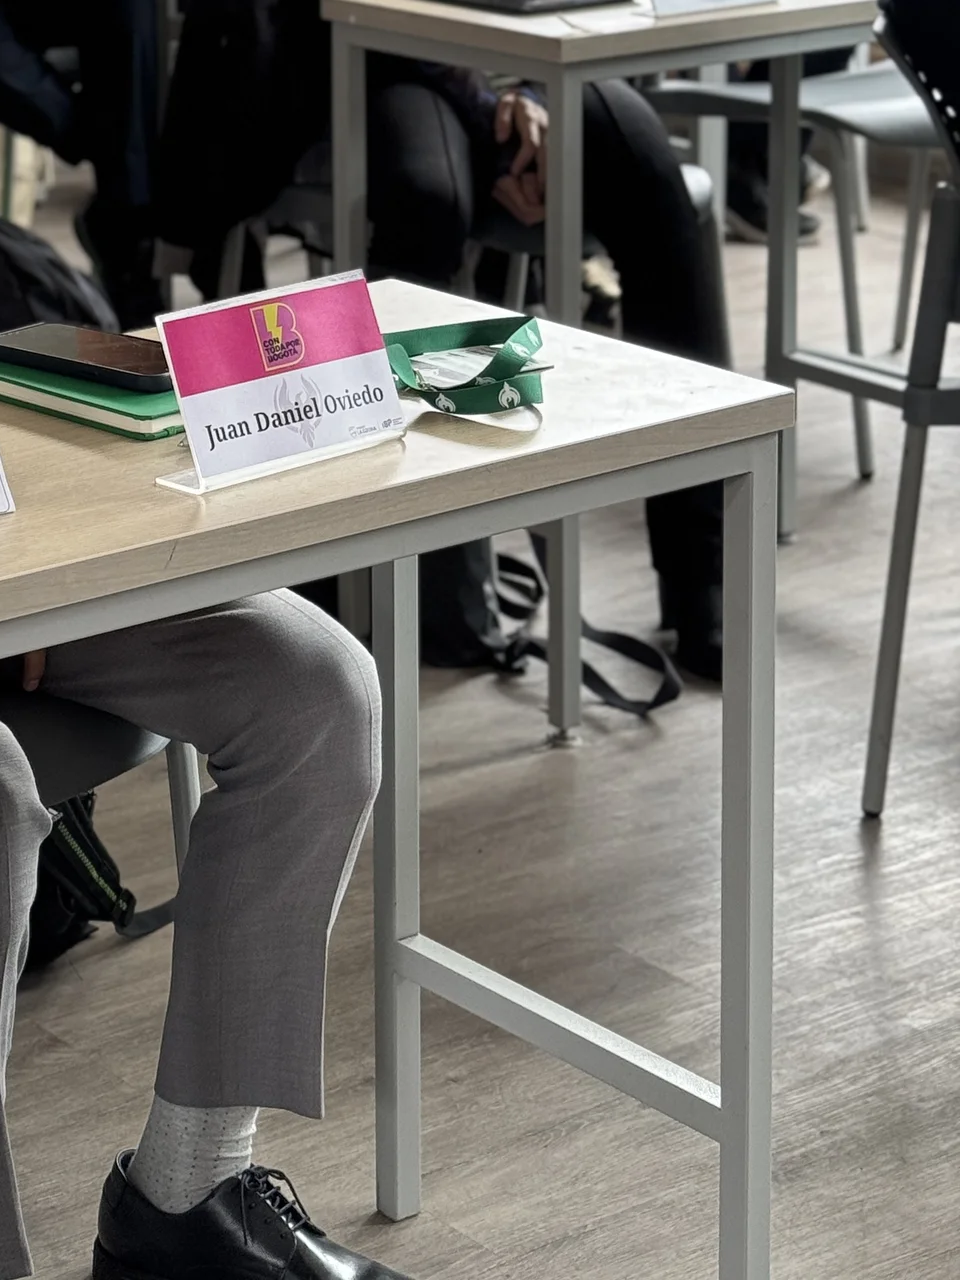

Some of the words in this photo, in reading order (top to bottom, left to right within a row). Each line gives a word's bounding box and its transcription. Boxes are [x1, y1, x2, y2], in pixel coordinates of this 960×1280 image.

[263, 337, 280, 348] CON
[265, 343, 286, 355] TODA
[205, 422, 252, 451] Juan
[253, 397, 321, 432] Daniel
[324, 384, 384, 415] Oviedo
